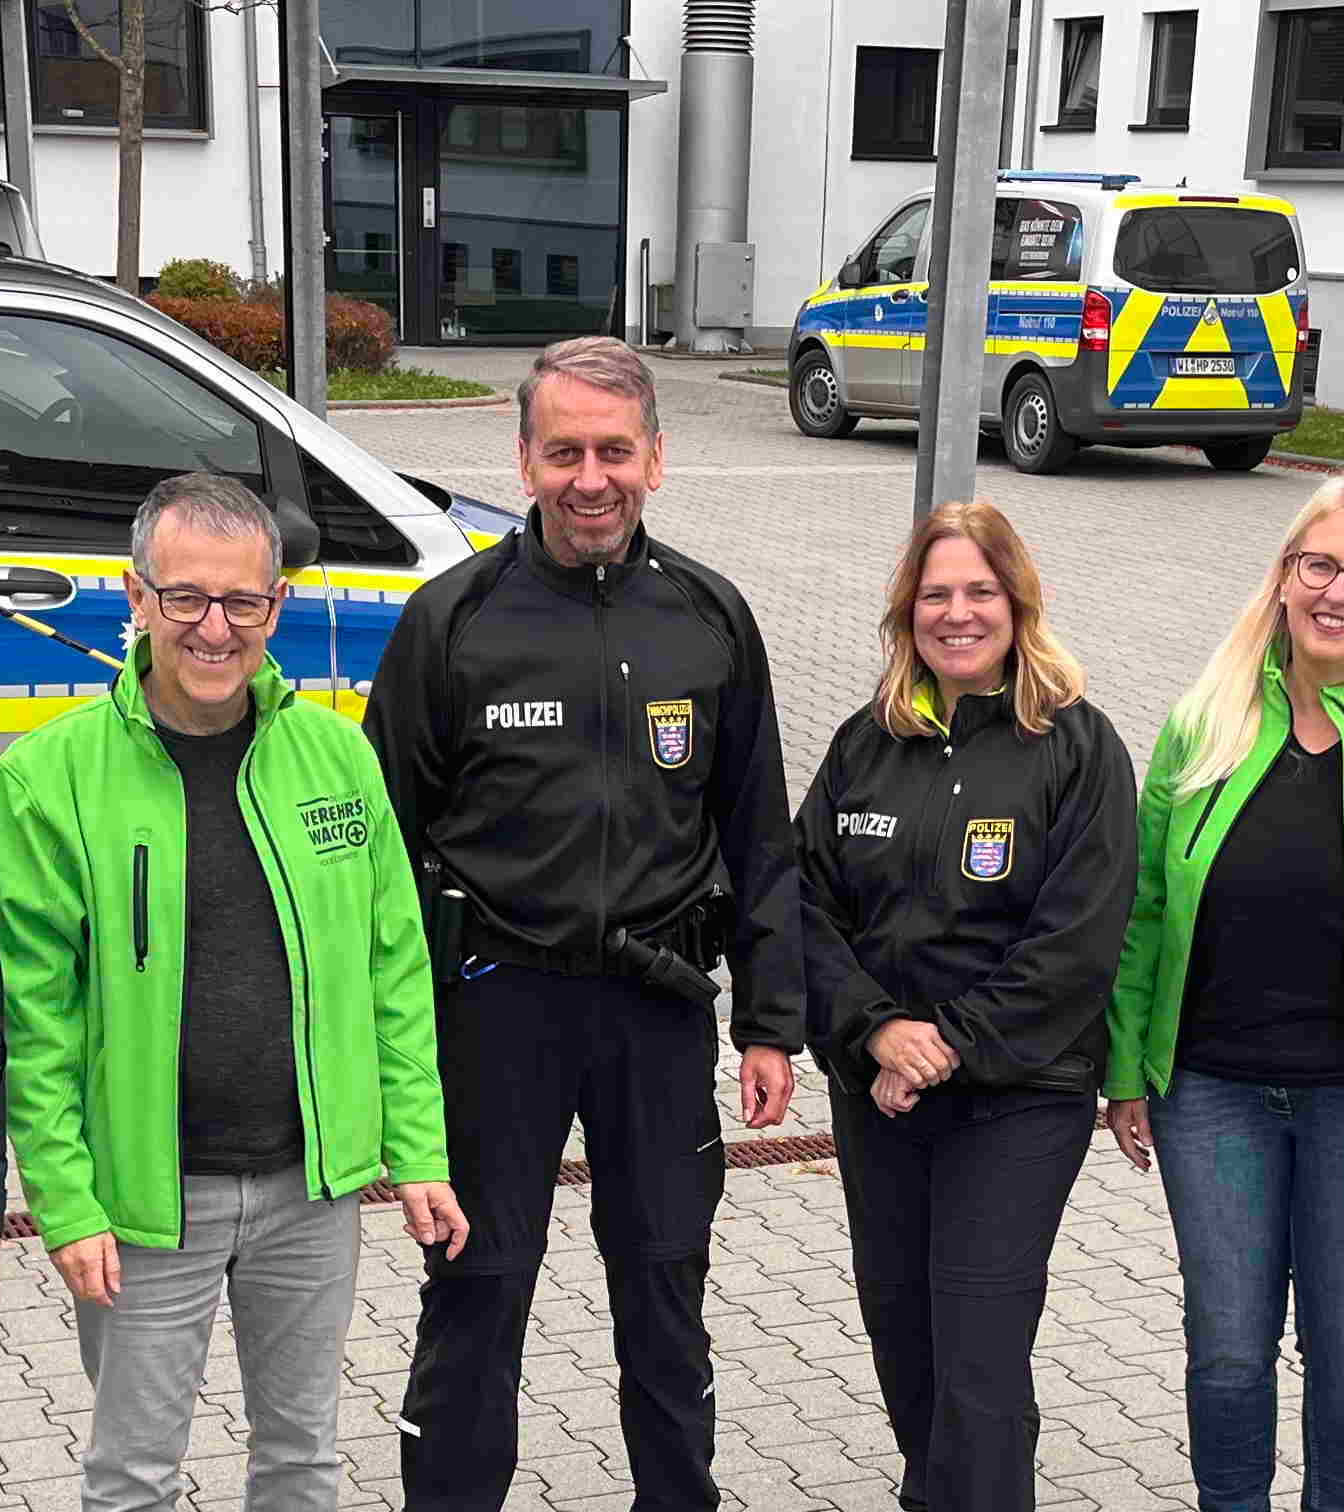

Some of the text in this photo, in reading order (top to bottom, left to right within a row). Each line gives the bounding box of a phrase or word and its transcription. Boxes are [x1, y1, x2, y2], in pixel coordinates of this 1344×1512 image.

[1161, 304, 1203, 318] POLIZEI
[485, 700, 564, 730] POLIZEI
[836, 812, 898, 838] POLIZEI
[968, 822, 1013, 834] POLIZEI
